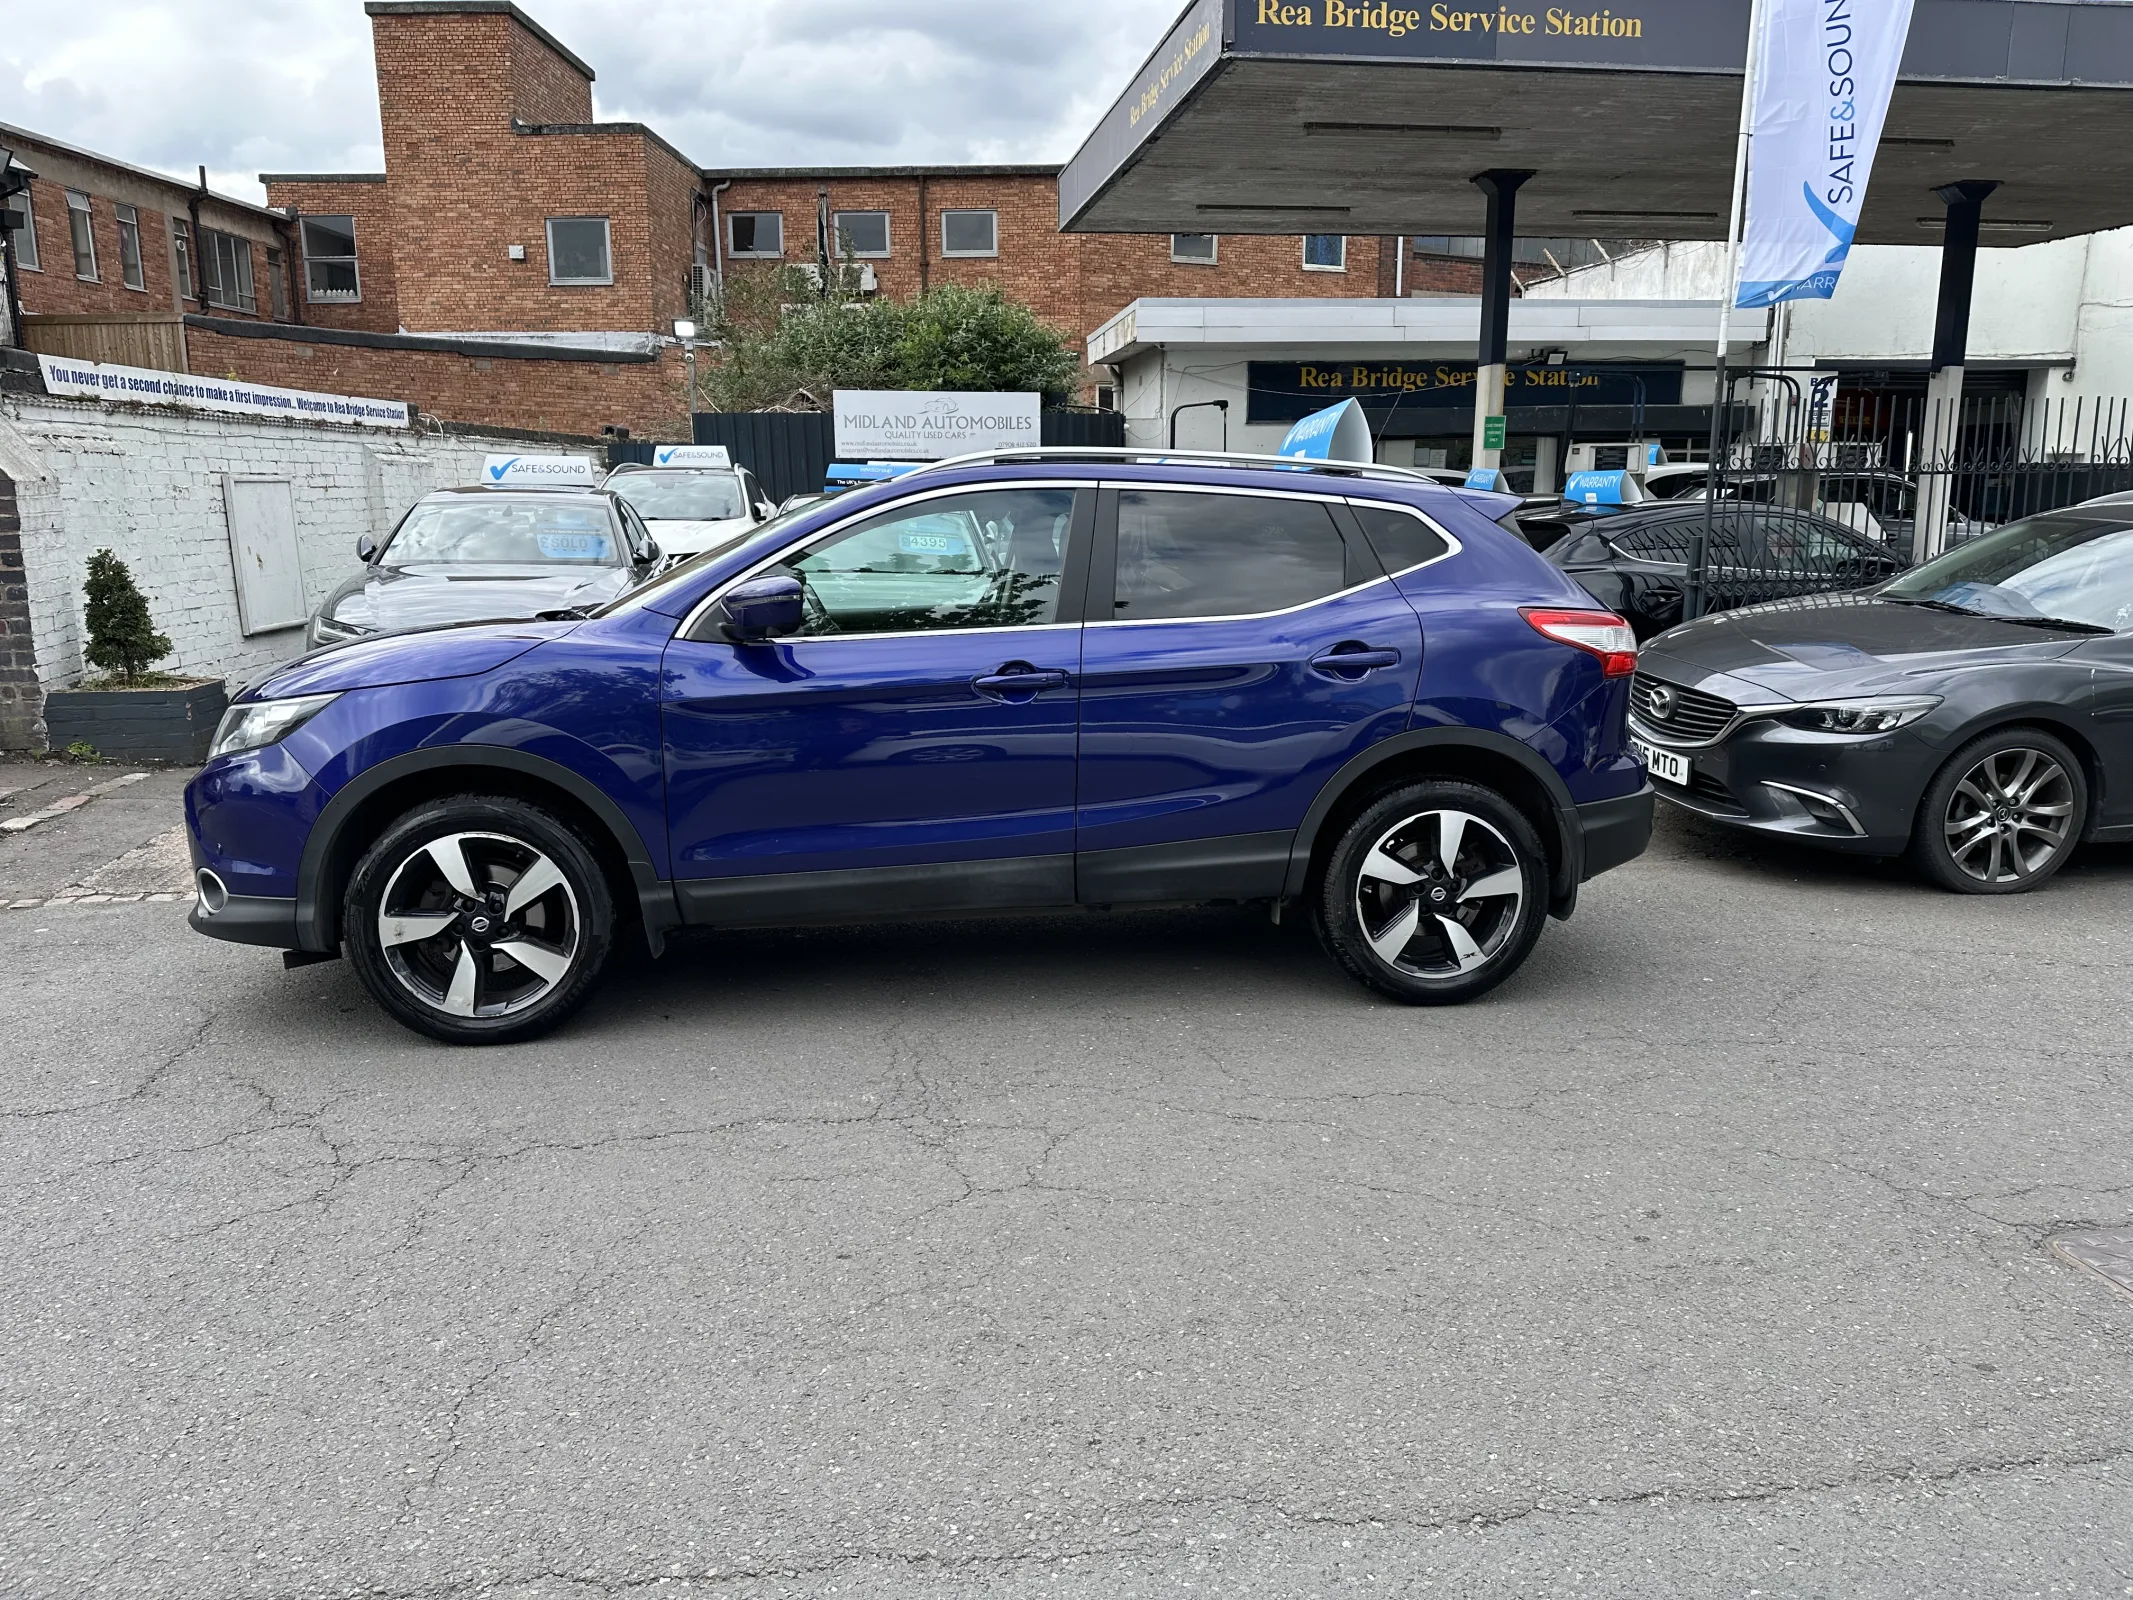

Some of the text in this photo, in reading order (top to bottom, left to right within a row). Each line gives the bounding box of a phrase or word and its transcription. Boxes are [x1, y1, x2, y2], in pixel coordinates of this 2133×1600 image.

[1255, 0, 1643, 38] Rea Bridge Service Station
[1130, 106, 1140, 129] Rea
[1160, 53, 1183, 92] Service
[1184, 22, 1210, 65] Station
[1299, 366, 1343, 387] Rea
[1352, 366, 1428, 393] Bridge
[1435, 366, 1515, 388] Sere
[49, 365, 69, 382] You
[71, 370, 100, 387] never
[101, 374, 119, 389] get
[120, 376, 127, 389] a
[128, 378, 161, 394] second
[163, 380, 195, 398] chance
[195, 384, 204, 398] to
[206, 387, 228, 401] make
[229, 391, 234, 401] a
[235, 389, 251, 404] first
[296, 397, 326, 413] Welcome
[327, 401, 334, 413] to
[334, 402, 346, 414] Rea
[346, 403, 365, 418] Bridge
[366, 404, 386, 419] Service
[386, 407, 405, 420] Station
[843, 414, 1032, 430] MIDLAND AUTOMOBILES
[884, 430, 921, 439] QUALITY
[923, 431, 943, 439] USED
[944, 431, 967, 439] CARS
[673, 451, 724, 459] SAFE&SOUND
[511, 463, 586, 474] SAFE&SOUND
[1579, 475, 1619, 488] WARRANTY
[551, 537, 588, 549] SOLD
[1652, 750, 1679, 778] MTO
